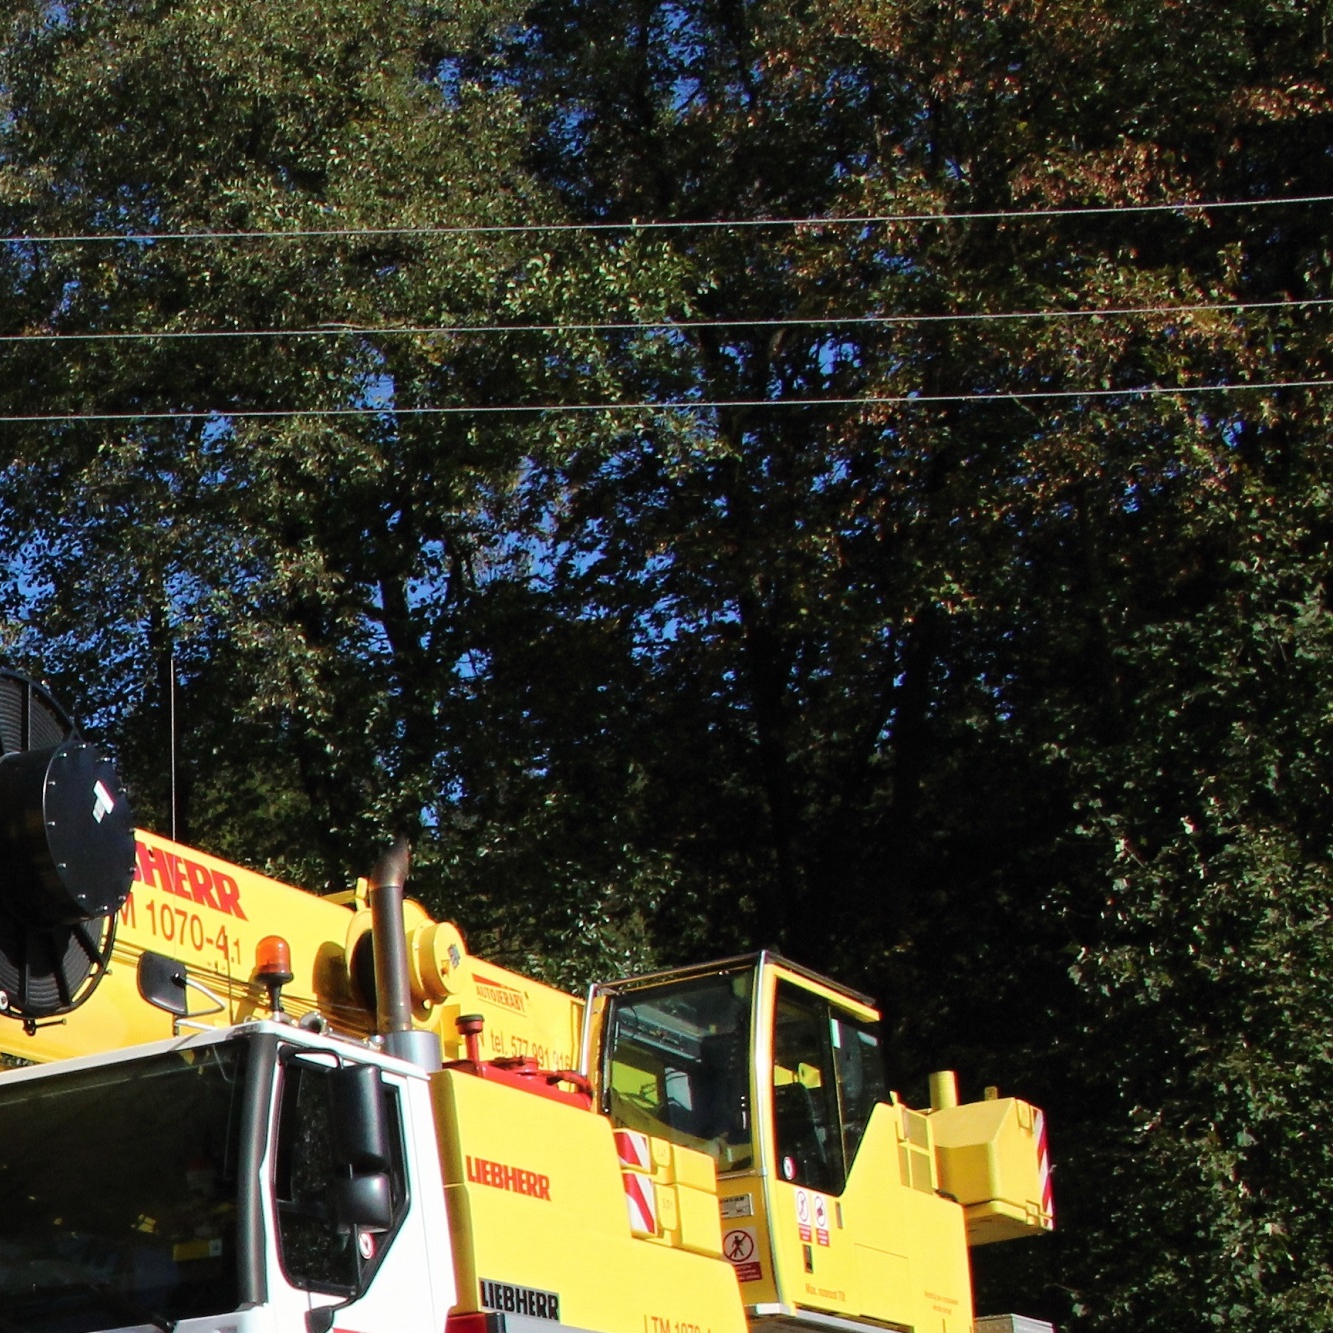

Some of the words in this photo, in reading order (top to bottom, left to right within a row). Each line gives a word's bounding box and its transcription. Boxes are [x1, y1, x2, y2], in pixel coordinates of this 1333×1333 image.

[134, 840, 249, 921] HERR
[145, 899, 241, 965] 1070-4.1
[476, 985, 525, 1013] AUTOJERABY
[465, 1155, 552, 1201] LIEBHERR
[480, 1280, 559, 1321] LIEBHERR
